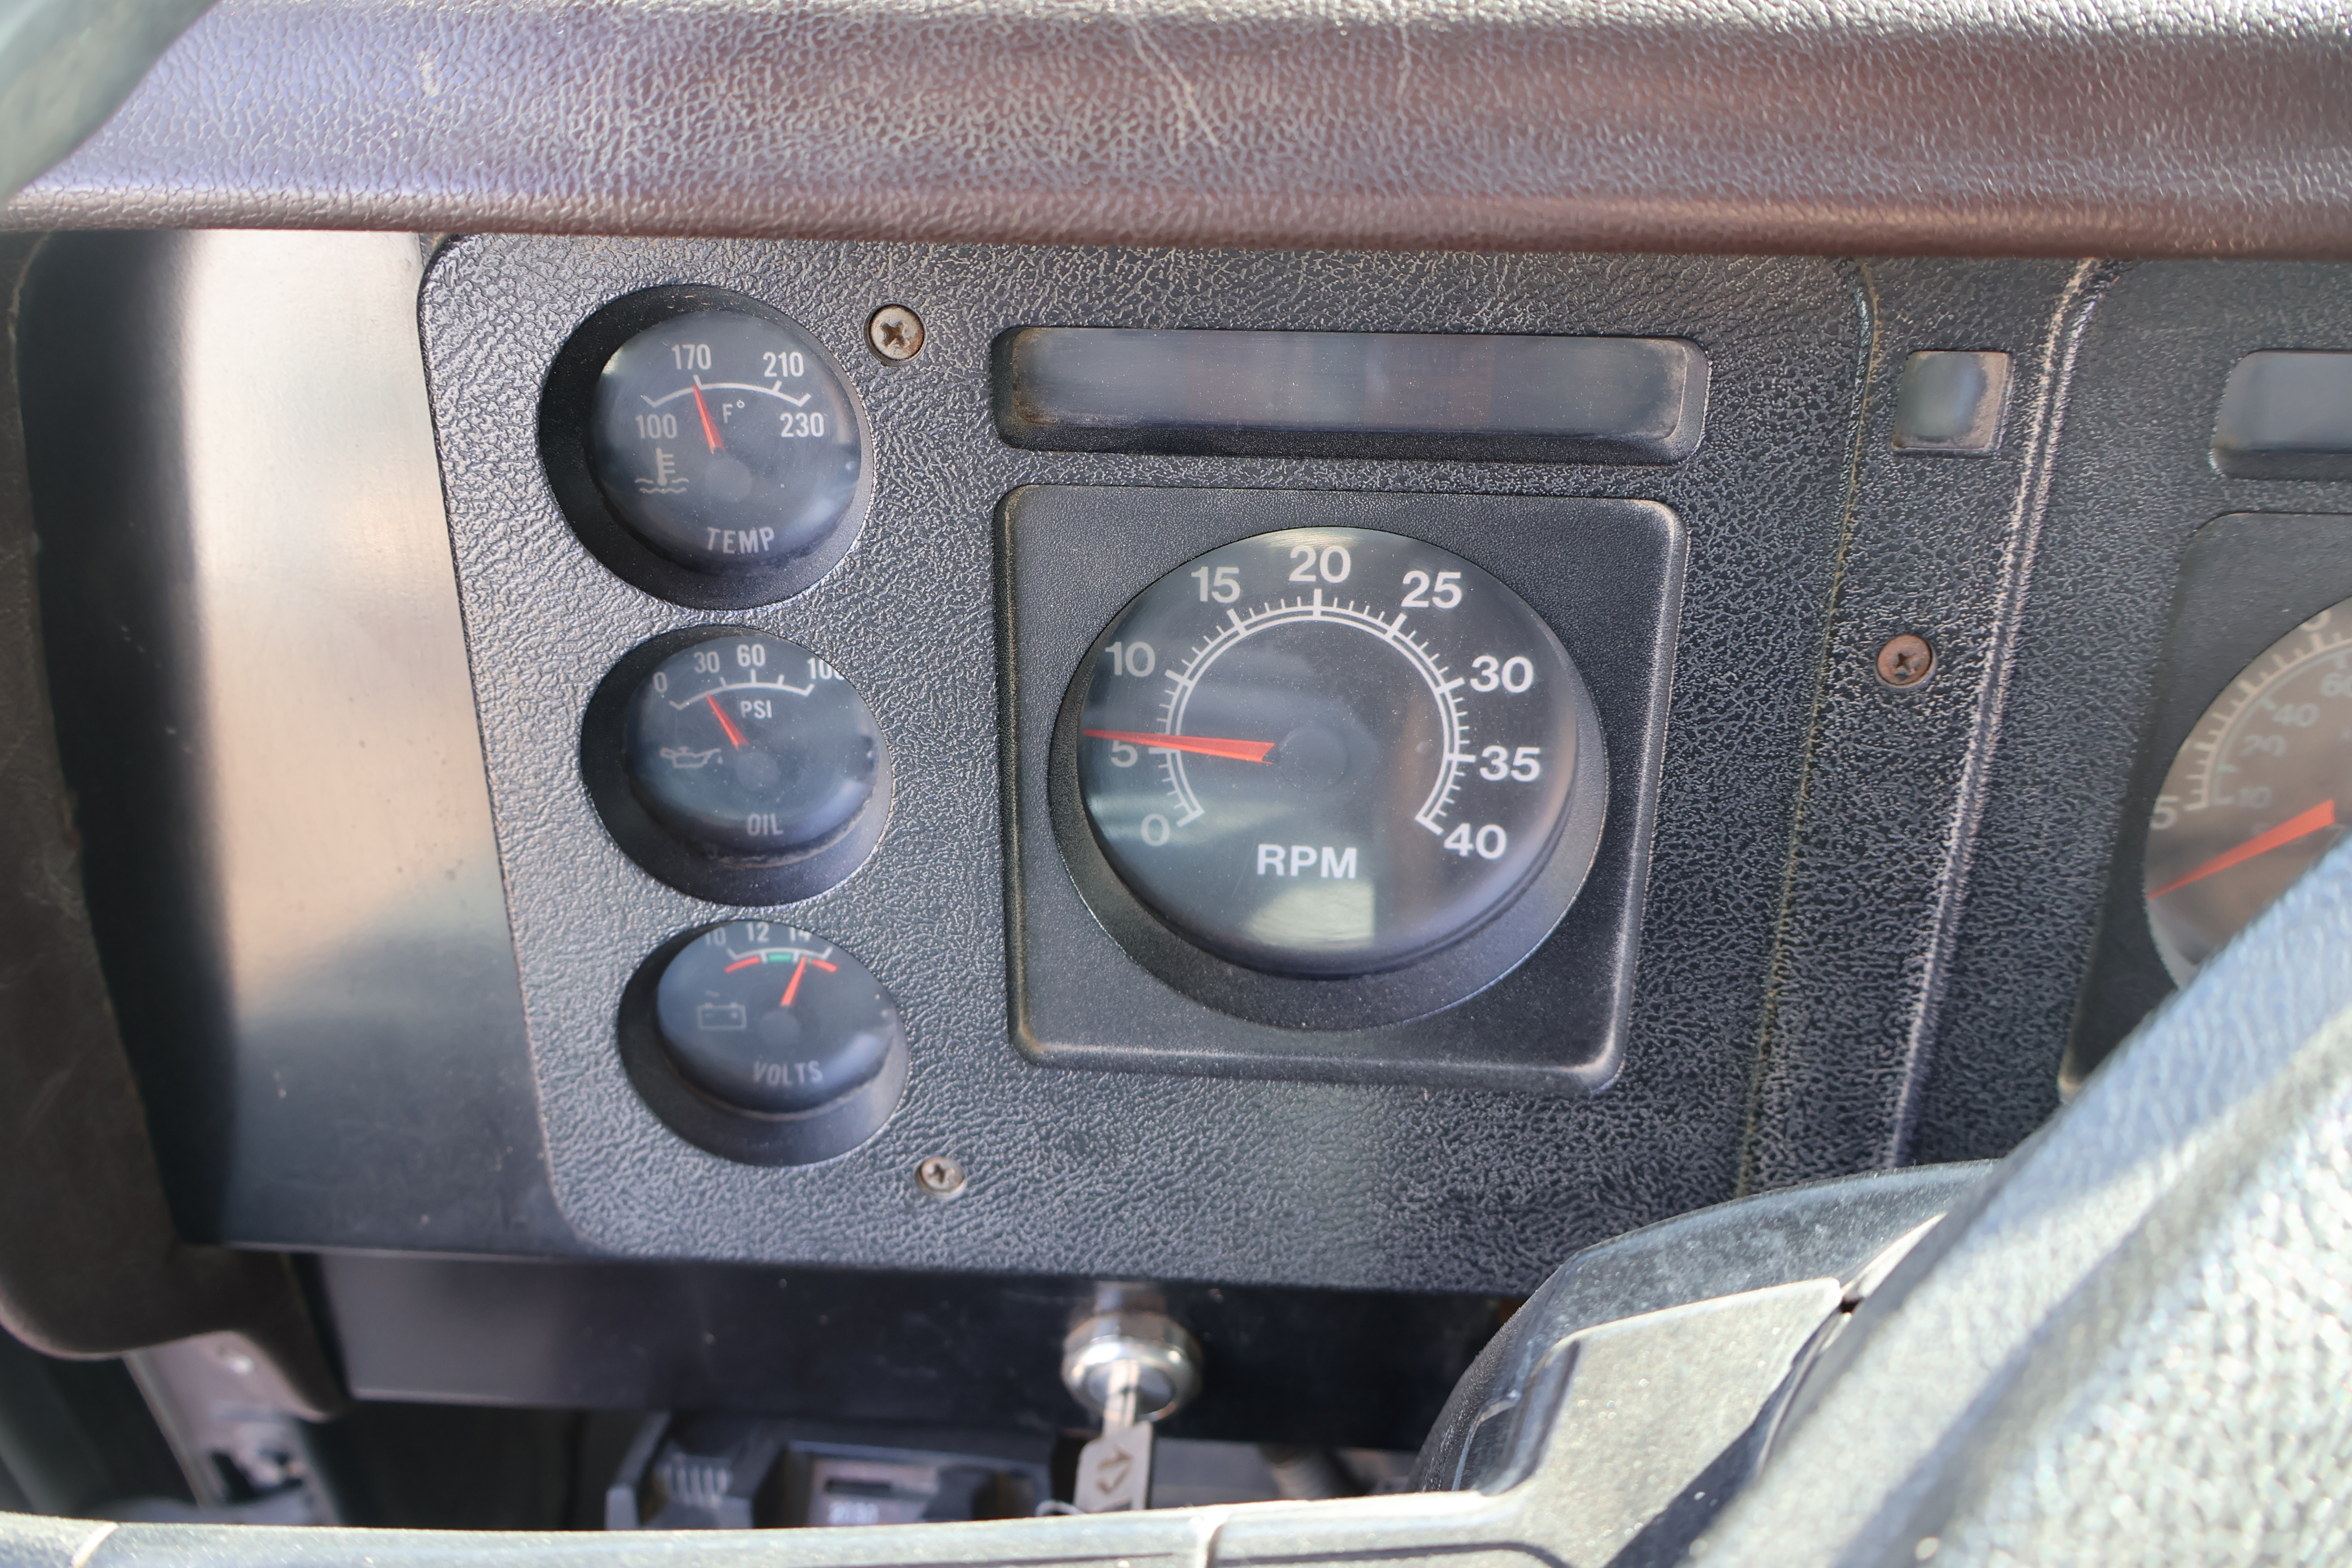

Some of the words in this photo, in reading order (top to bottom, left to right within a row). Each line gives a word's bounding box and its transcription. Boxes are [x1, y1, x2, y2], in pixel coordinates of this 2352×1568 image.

[671, 344, 711, 370] 170
[763, 352, 804, 377] 210
[635, 414, 677, 439] 100
[780, 412, 824, 437] 230
[707, 526, 775, 554] TEMP
[1289, 546, 1351, 583] 20
[1191, 566, 1240, 603] 15
[1401, 571, 1463, 609] 25
[694, 651, 720, 674] 30
[737, 644, 766, 667] 60
[1105, 641, 1156, 677] 10
[653, 672, 668, 693] 0
[1470, 655, 1534, 693] 30
[740, 700, 772, 719] PSI
[2272, 702, 2319, 727] 40
[1111, 741, 1138, 768] 5
[1479, 746, 1541, 782] 35
[2239, 786, 2272, 808] 10
[747, 813, 783, 836] OIL
[2150, 795, 2180, 829] 5
[1141, 813, 1170, 846] 0
[1444, 823, 1507, 859] 40
[1258, 844, 1357, 879] RPM
[746, 922, 770, 943] 12
[753, 1061, 822, 1085] VOLTS
